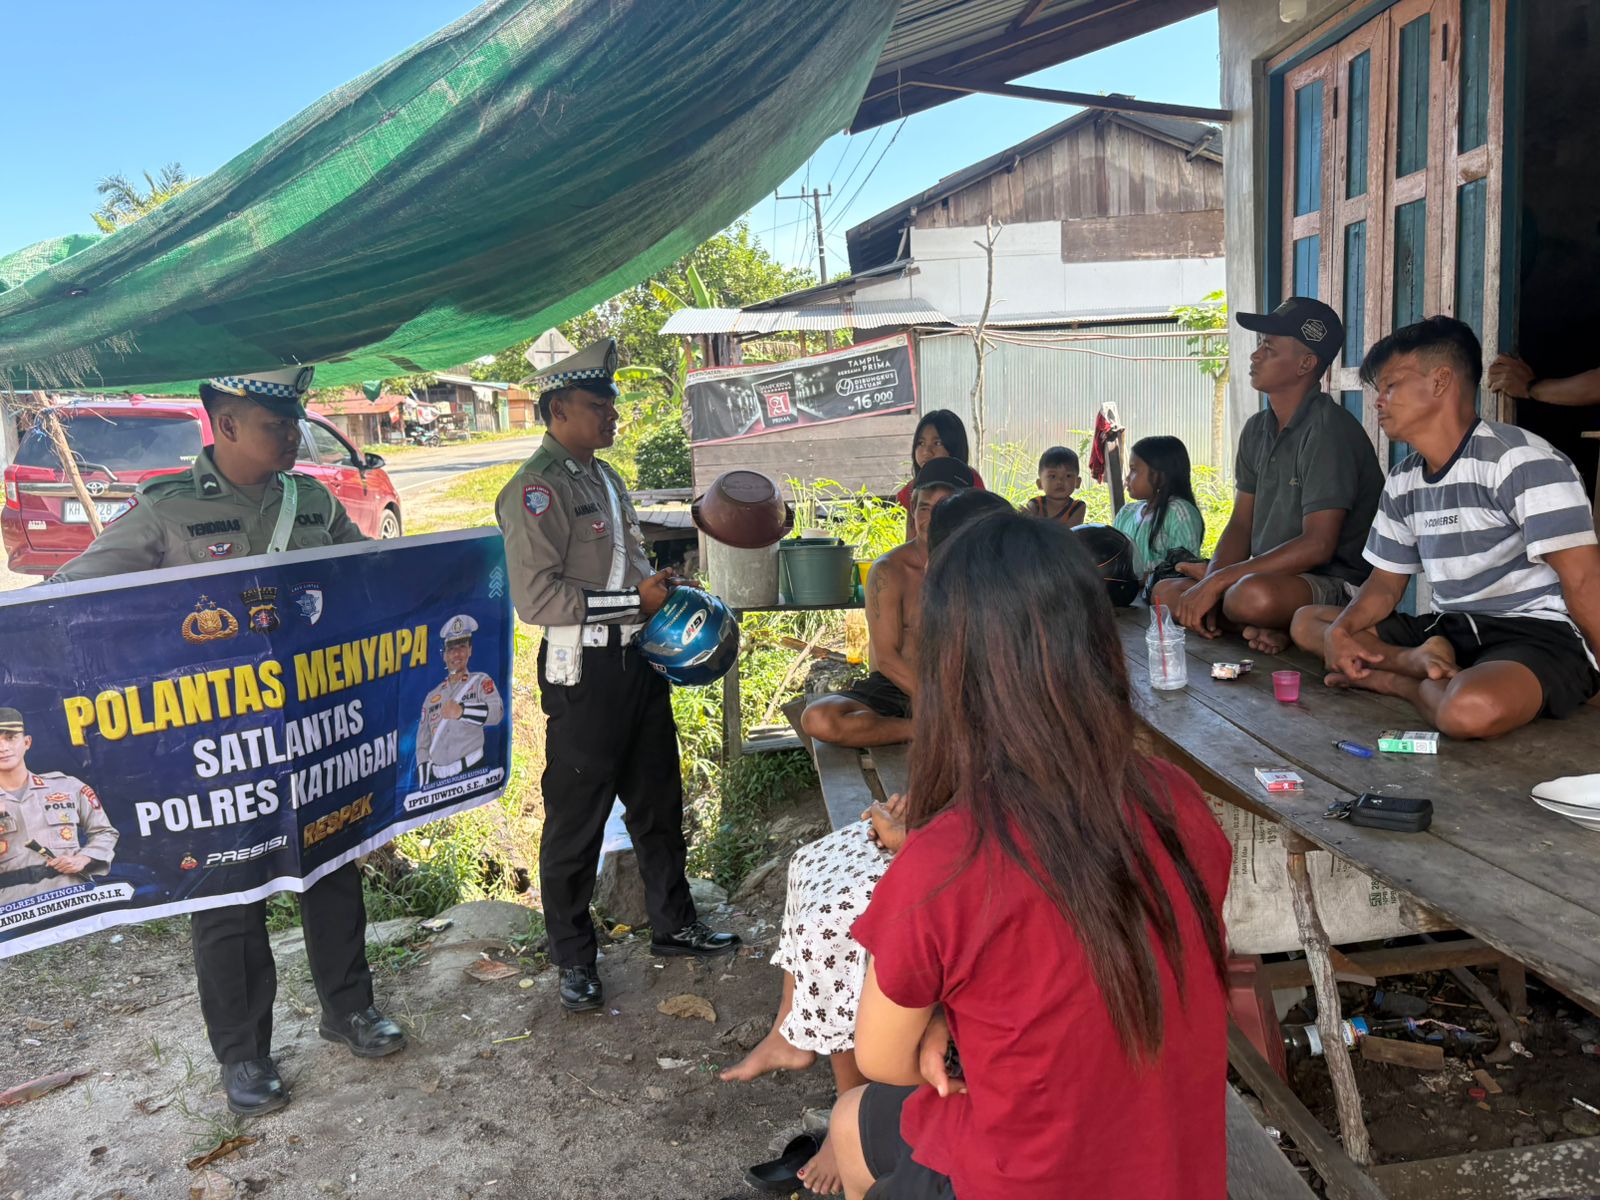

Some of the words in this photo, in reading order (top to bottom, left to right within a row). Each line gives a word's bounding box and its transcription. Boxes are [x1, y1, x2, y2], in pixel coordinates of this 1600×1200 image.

[838, 368, 862, 376] BERSAMA
[862, 361, 891, 372] PRIMA
[848, 355, 881, 368] TAMPIL
[854, 373, 894, 384] DIBUNGKUS
[855, 381, 882, 390] SATUAN
[68, 504, 80, 516] KH
[187, 518, 240, 537] YENDRIAS
[63, 660, 286, 746] POLANTAS
[294, 624, 429, 701] MENYAPA
[461, 692, 477, 701] OLRI
[193, 699, 364, 779] SATLANTAS
[135, 779, 278, 837] POLRES
[290, 730, 398, 810] KATINGAN
[408, 796, 429, 809] IPTU
[432, 786, 466, 802] JUWITO,
[486, 774, 501, 786] MM
[44, 802, 75, 811] POLRI
[304, 792, 374, 849] RESPEK
[206, 836, 288, 866] PRESISI
[0, 896, 36, 914] POLRES
[37, 884, 86, 902] KATINGAN
[0, 908, 36, 928] ANDRA
